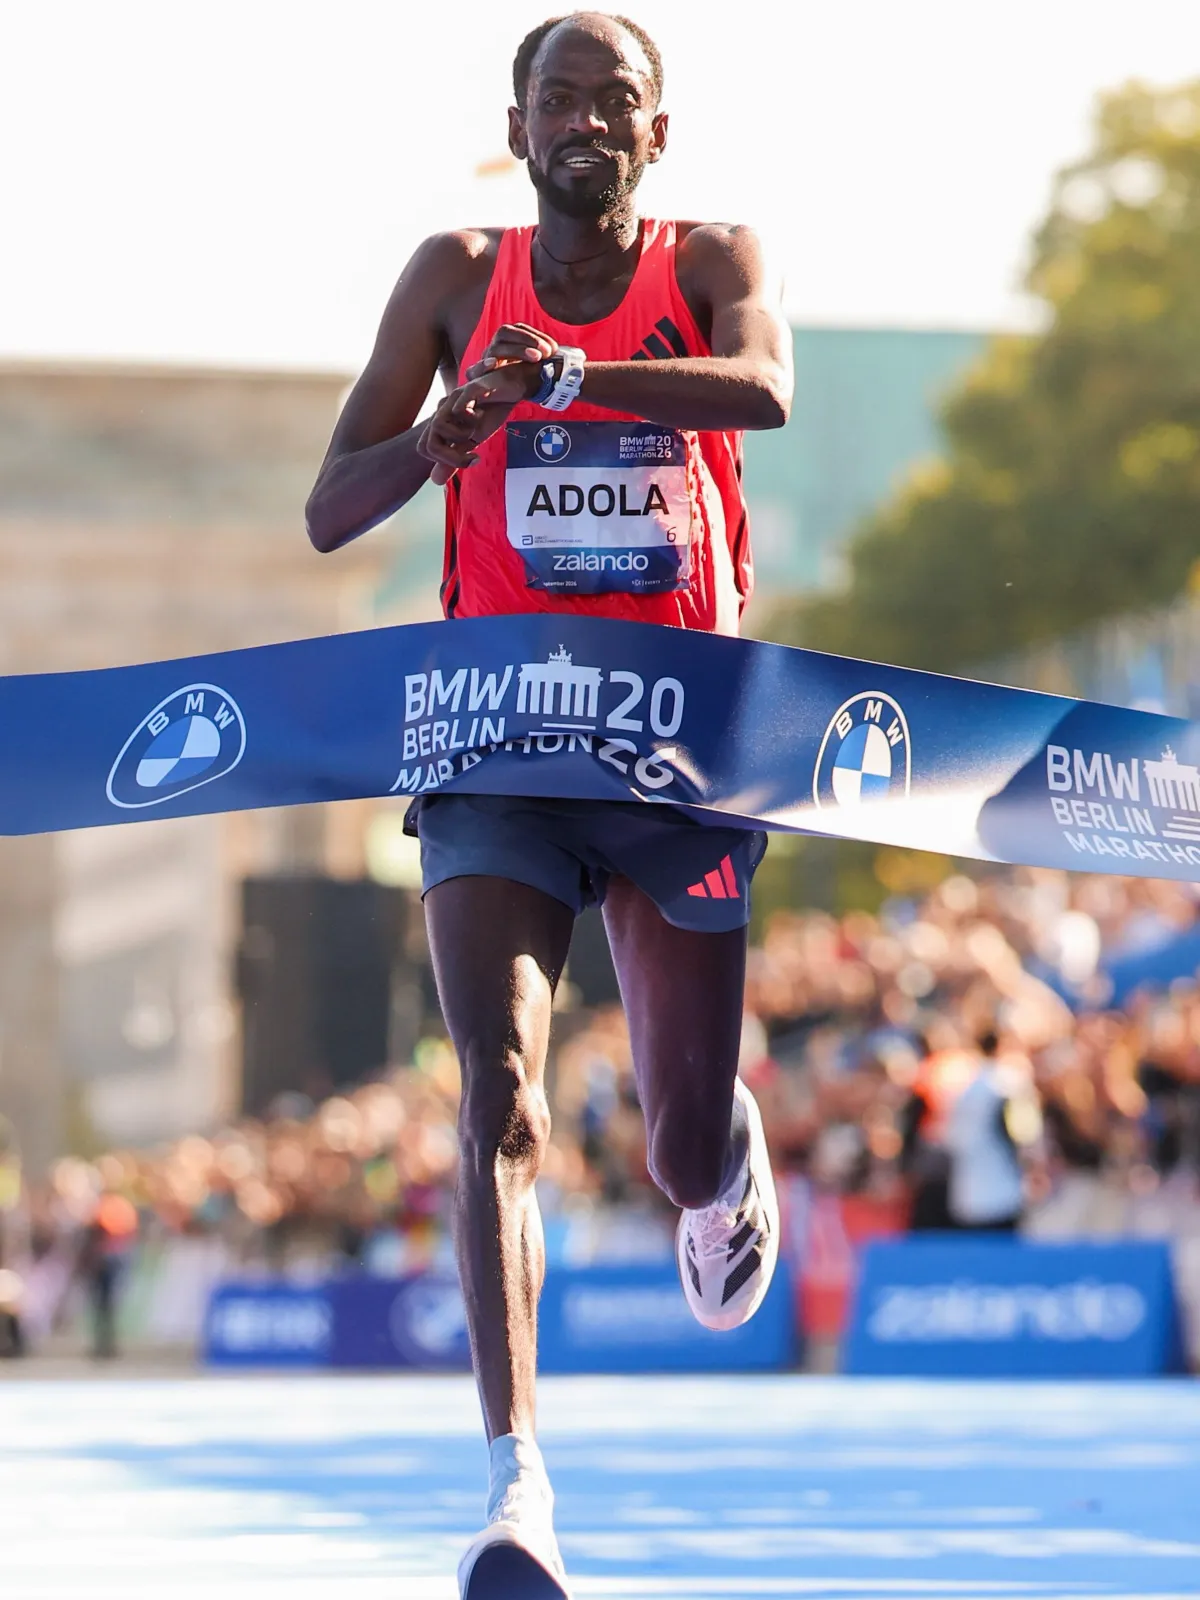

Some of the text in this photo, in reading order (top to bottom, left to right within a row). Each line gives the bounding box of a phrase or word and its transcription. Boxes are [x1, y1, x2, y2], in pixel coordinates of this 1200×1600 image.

[620, 435, 671, 447] BMW 20
[657, 447, 672, 458] 26
[526, 484, 670, 517] ADOLA
[666, 526, 677, 543] 6
[553, 552, 648, 571] zalando
[147, 692, 235, 737] BMW
[404, 665, 685, 737] BMW 20
[402, 717, 505, 761] BERLIN
[836, 699, 904, 747] BMW
[1047, 744, 1140, 802] BMW
[1050, 797, 1157, 836] BERLIN
